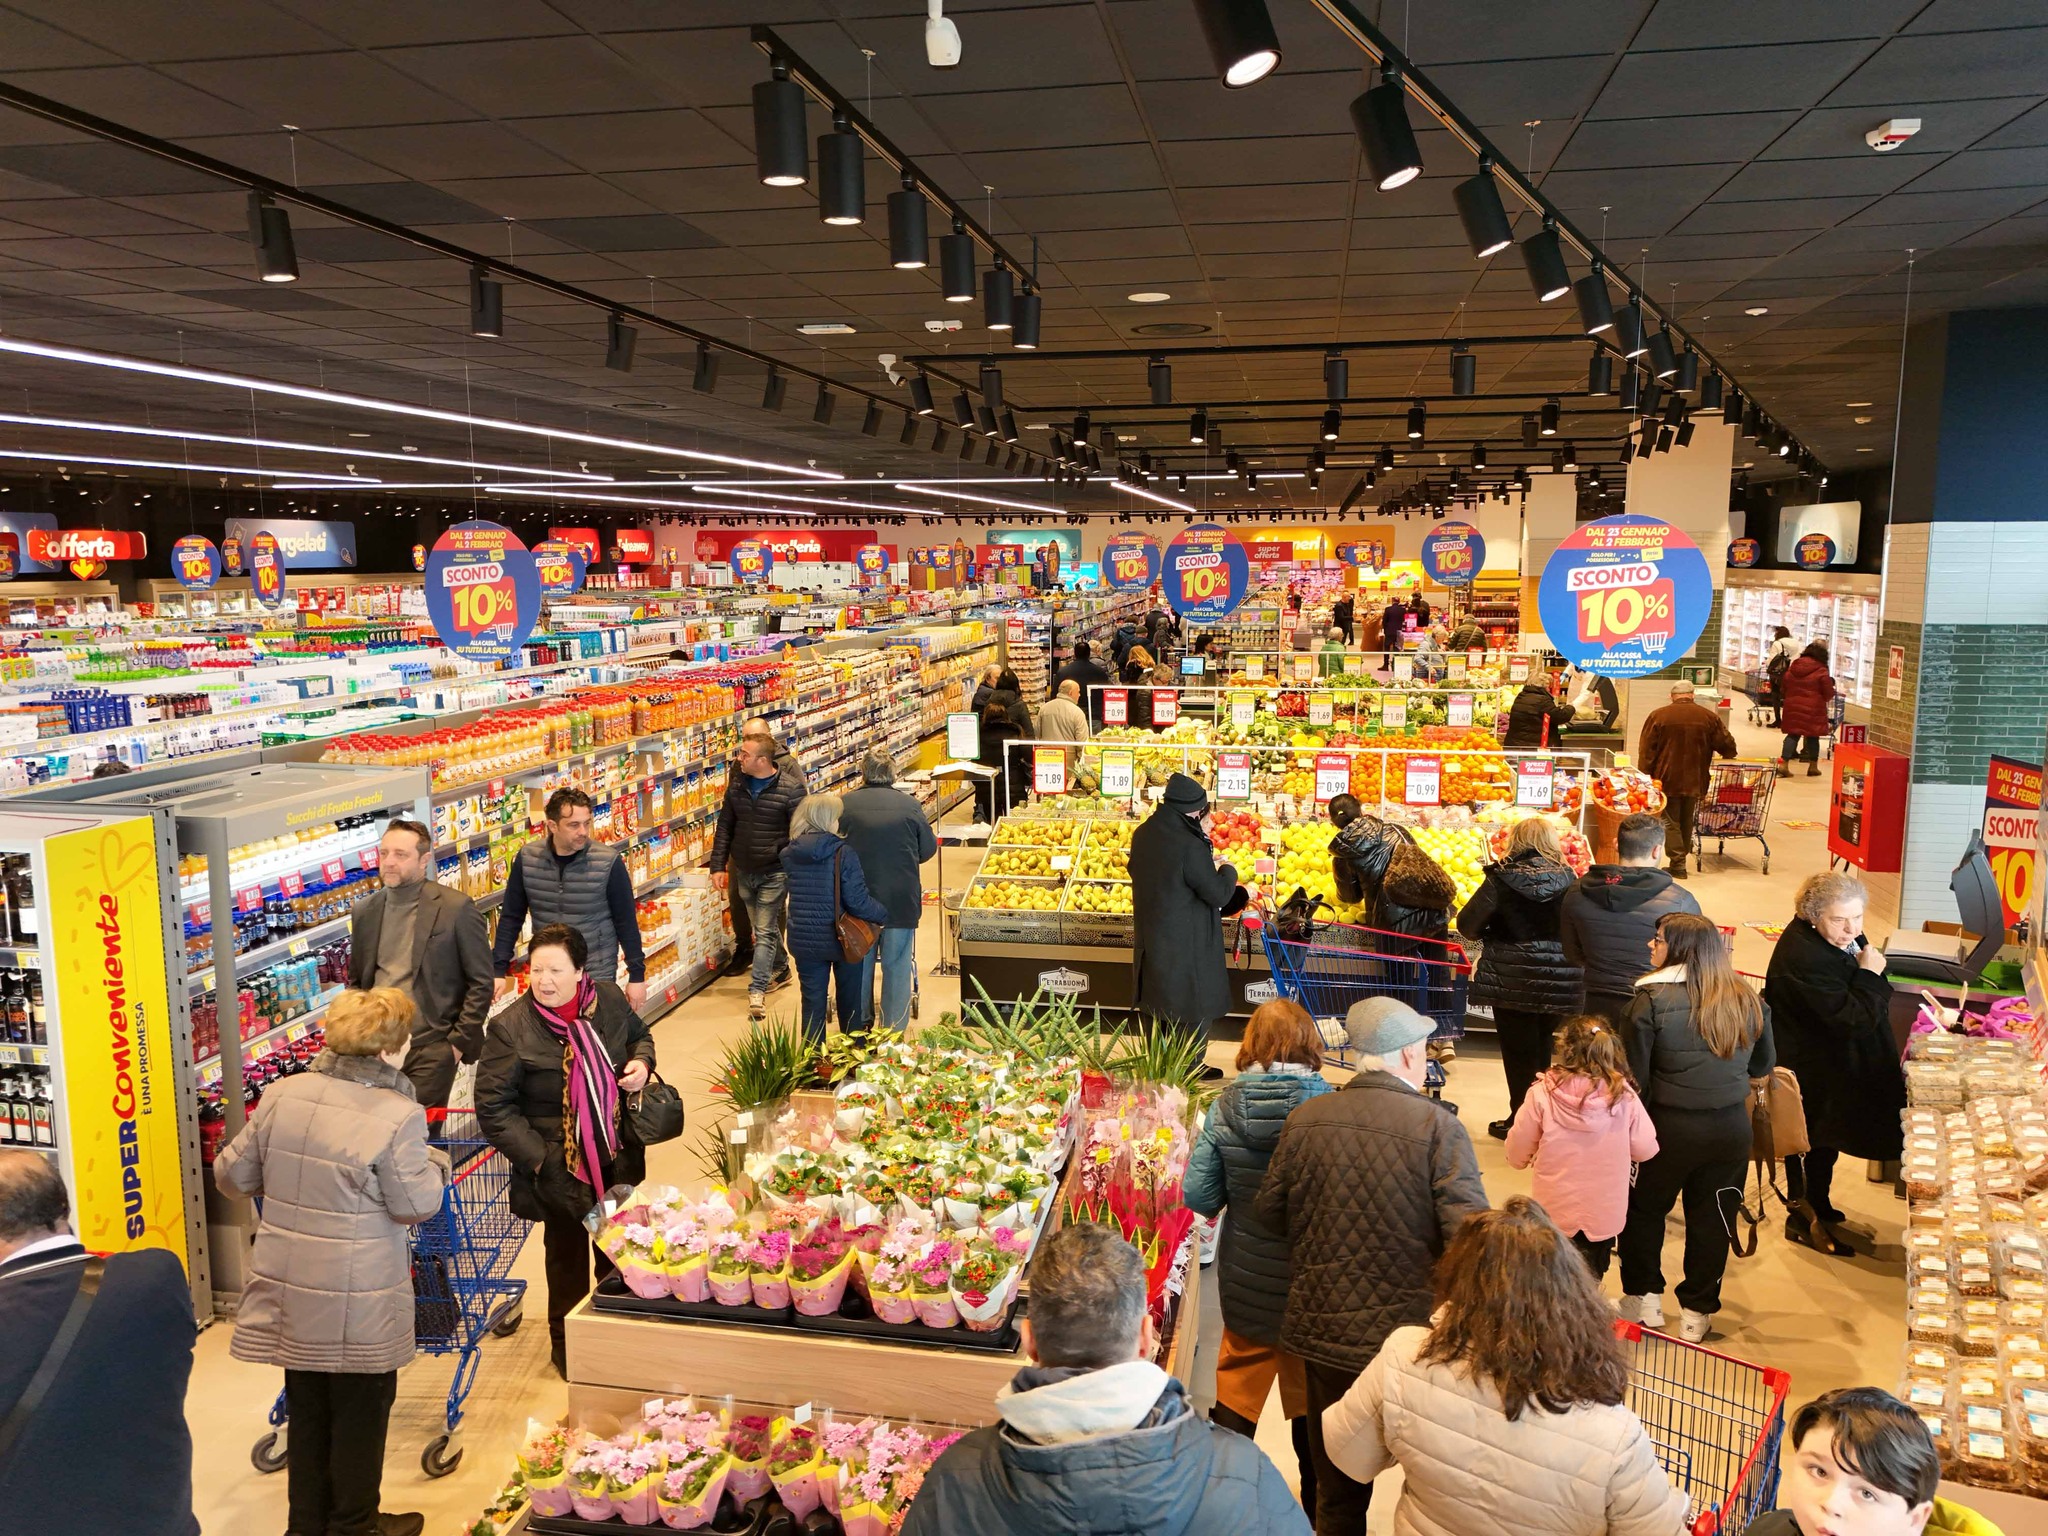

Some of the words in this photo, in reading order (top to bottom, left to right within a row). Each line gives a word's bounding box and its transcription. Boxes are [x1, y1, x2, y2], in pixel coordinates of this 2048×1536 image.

[1586, 528, 1606, 536] DAL
[1607, 527, 1620, 536] 23
[1621, 526, 1670, 536] GENNAIO
[47, 533, 115, 558] offerta
[617, 538, 649, 555] Takeaway
[1434, 542, 1464, 550] SCONTO
[1591, 538, 1604, 546] AL
[1606, 538, 1613, 546] 2
[1614, 537, 1663, 546] FEBBRAIO
[227, 555, 240, 566] 10%
[1114, 551, 1140, 559] SCONTO
[1179, 555, 1218, 567] SCONTO
[1437, 550, 1470, 570] 10%
[1804, 550, 1826, 560] 10%
[184, 560, 210, 577] 10%
[741, 558, 762, 570] 10%
[865, 559, 882, 569] 10%
[1117, 560, 1146, 578] 10%
[259, 566, 277, 590] 10%
[447, 565, 499, 583] SCONTO
[542, 565, 572, 583] 10%
[1573, 566, 1652, 586] SCONTO
[1183, 568, 1227, 598] 10%
[454, 584, 513, 626] 10%
[1582, 588, 1668, 637] 10%
[1390, 713, 1403, 721] 1.89
[1045, 774, 1061, 784] 1.89
[1112, 776, 1129, 786] 1.89
[1996, 768, 2012, 782] DAL
[2012, 772, 2024, 785] 23
[1228, 780, 1246, 790] 2.15
[1327, 781, 1345, 793] 0.99
[1417, 784, 1436, 795] 0.99
[1529, 786, 1548, 798] 1.69
[1999, 784, 2009, 797] AL
[2010, 786, 2017, 798] 2
[286, 806, 316, 827] Succhi
[317, 804, 327, 817] di
[327, 801, 353, 816] Frutta
[354, 790, 383, 809] Freschi
[1992, 849, 2035, 913] 10
[135, 1002, 150, 1074] PROMESSA
[139, 1076, 151, 1106] UNA
